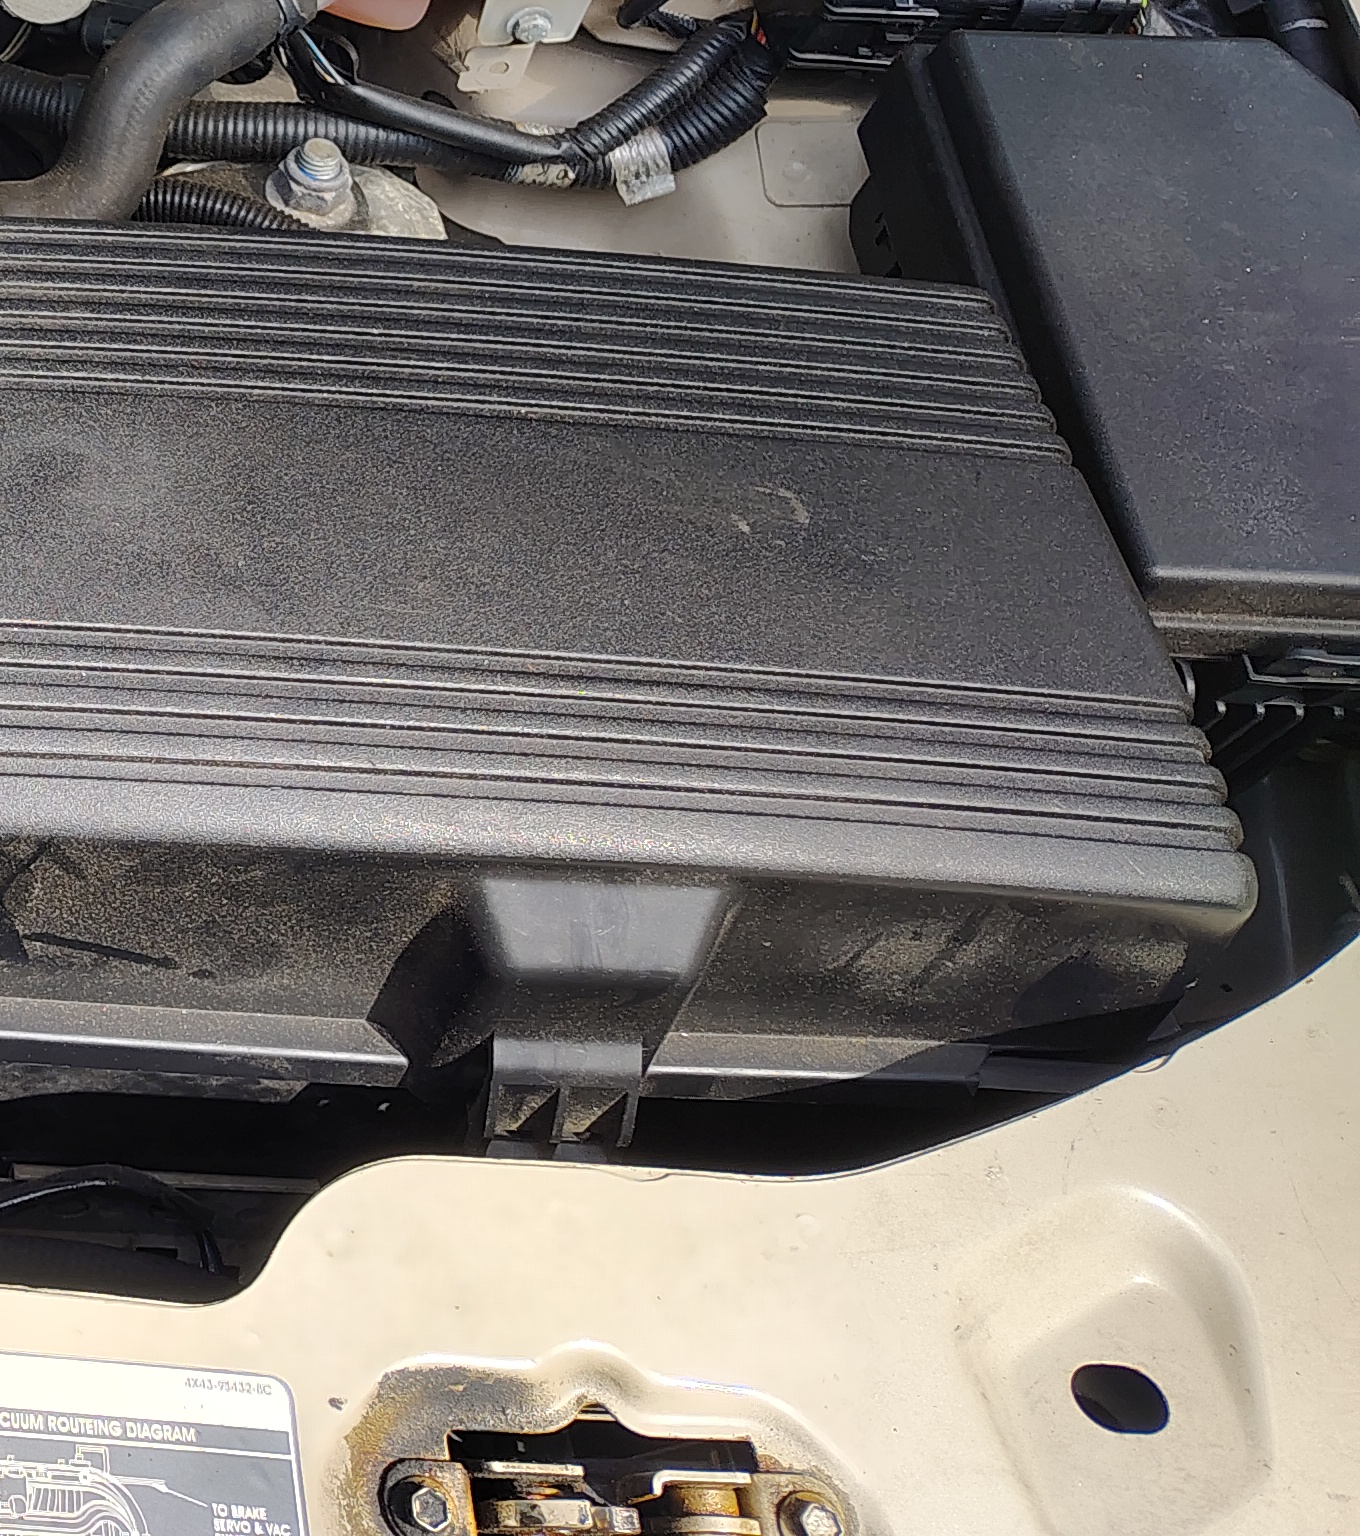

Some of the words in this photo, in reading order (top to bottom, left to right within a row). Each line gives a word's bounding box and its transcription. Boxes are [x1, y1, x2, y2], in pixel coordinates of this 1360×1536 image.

[47, 1415, 123, 1437] ROUTEING
[125, 1421, 197, 1443] DIAGRAM
[212, 1503, 227, 1517] TO
[231, 1505, 267, 1520] BRAKE
[213, 1518, 251, 1533] SERVO
[265, 1522, 291, 1536] VAC
